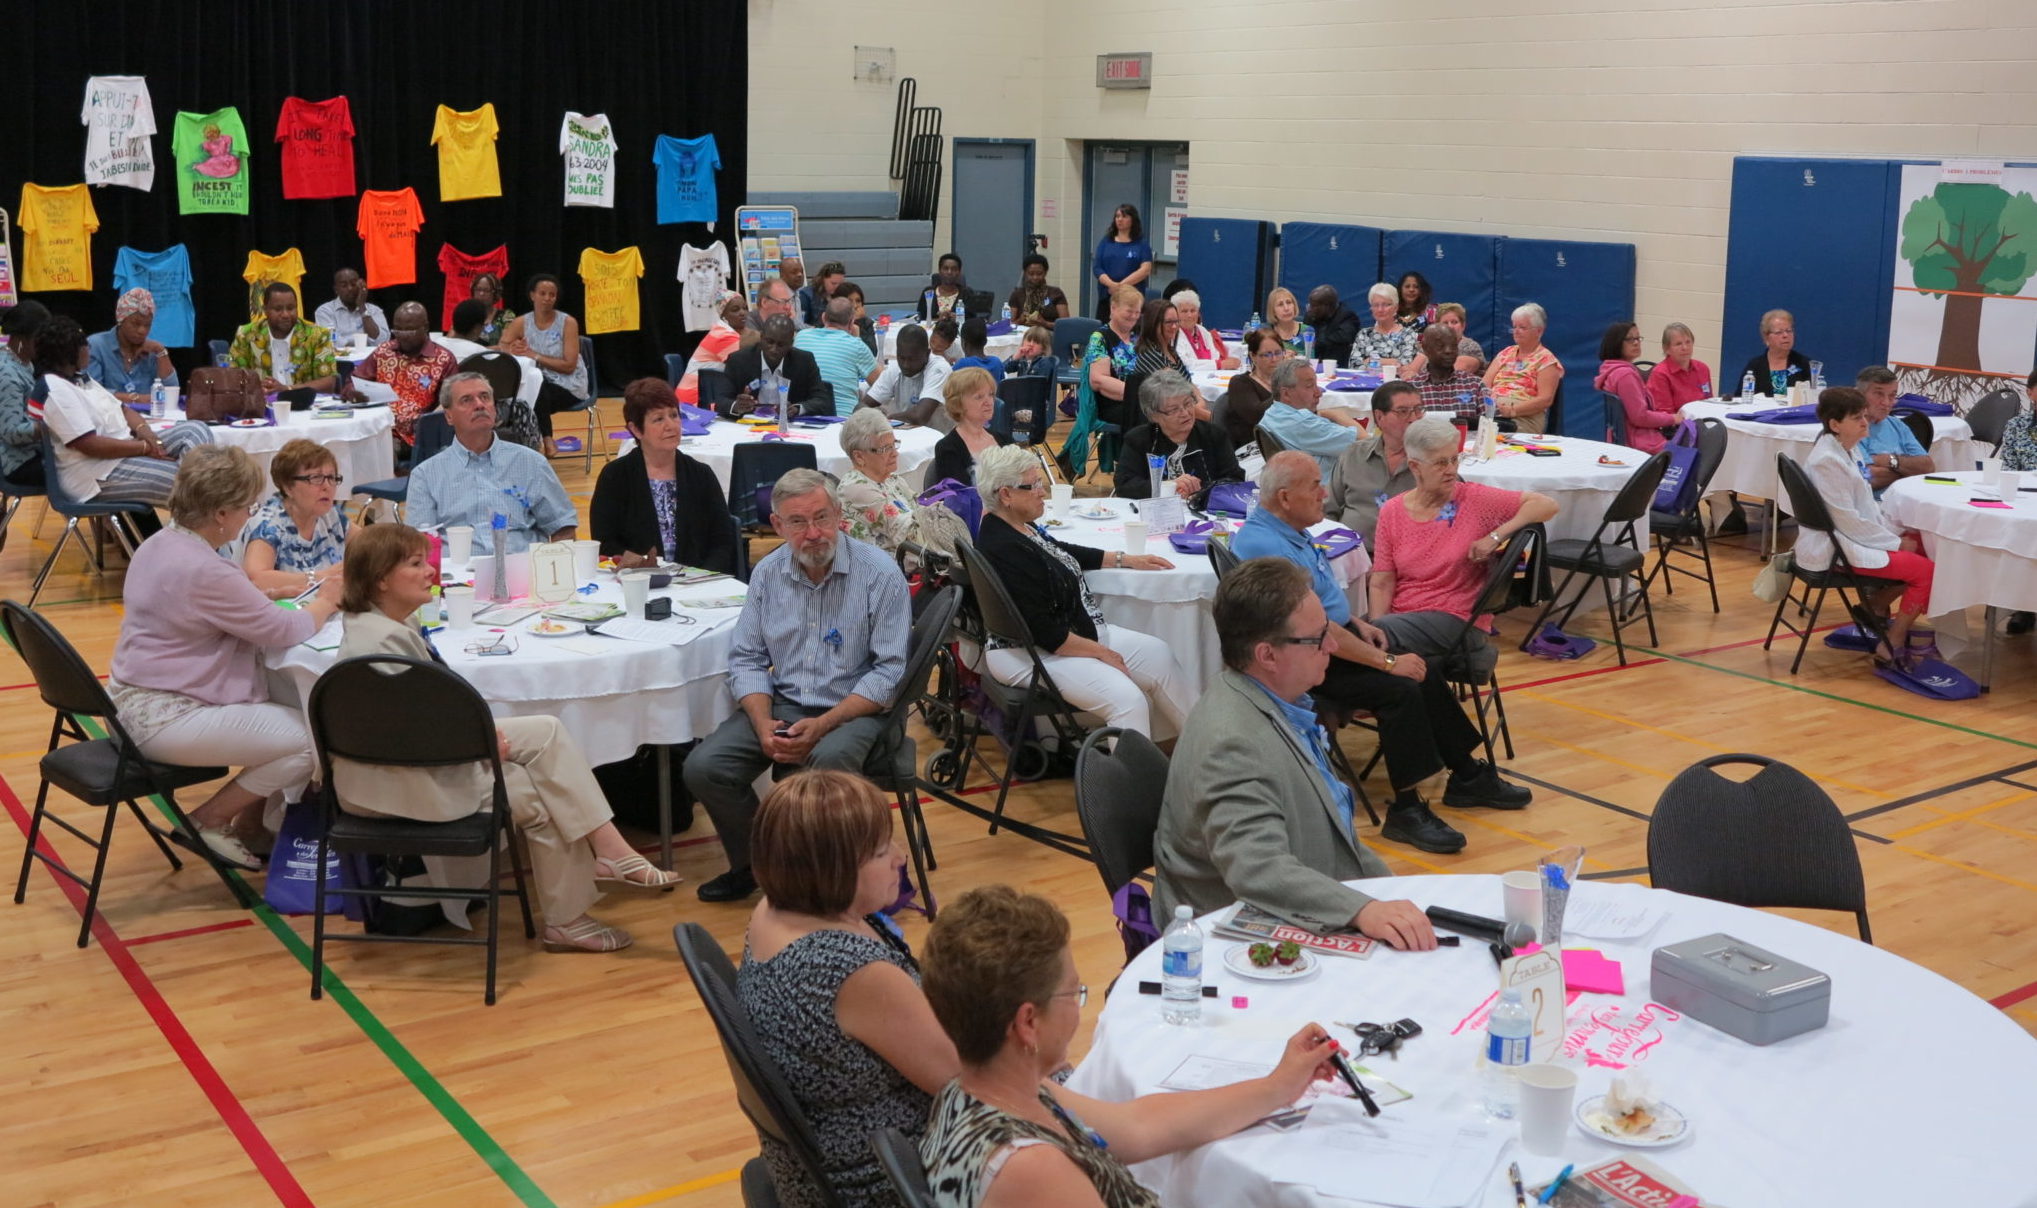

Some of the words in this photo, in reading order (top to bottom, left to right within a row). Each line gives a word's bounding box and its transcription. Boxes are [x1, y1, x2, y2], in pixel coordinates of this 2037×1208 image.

[1106, 61, 1123, 78] EXIT
[98, 113, 117, 129] SUR
[110, 131, 124, 147] ET
[294, 127, 323, 143] LONG
[569, 139, 611, 158] SANDRA
[192, 181, 232, 192] INCEST
[586, 172, 604, 185] PAS
[51, 272, 80, 284] SEUL
[551, 561, 559, 585] 1
[1277, 928, 1368, 952] L'Action
[1518, 961, 1551, 980] TABLE
[1531, 987, 1544, 1037] 2
